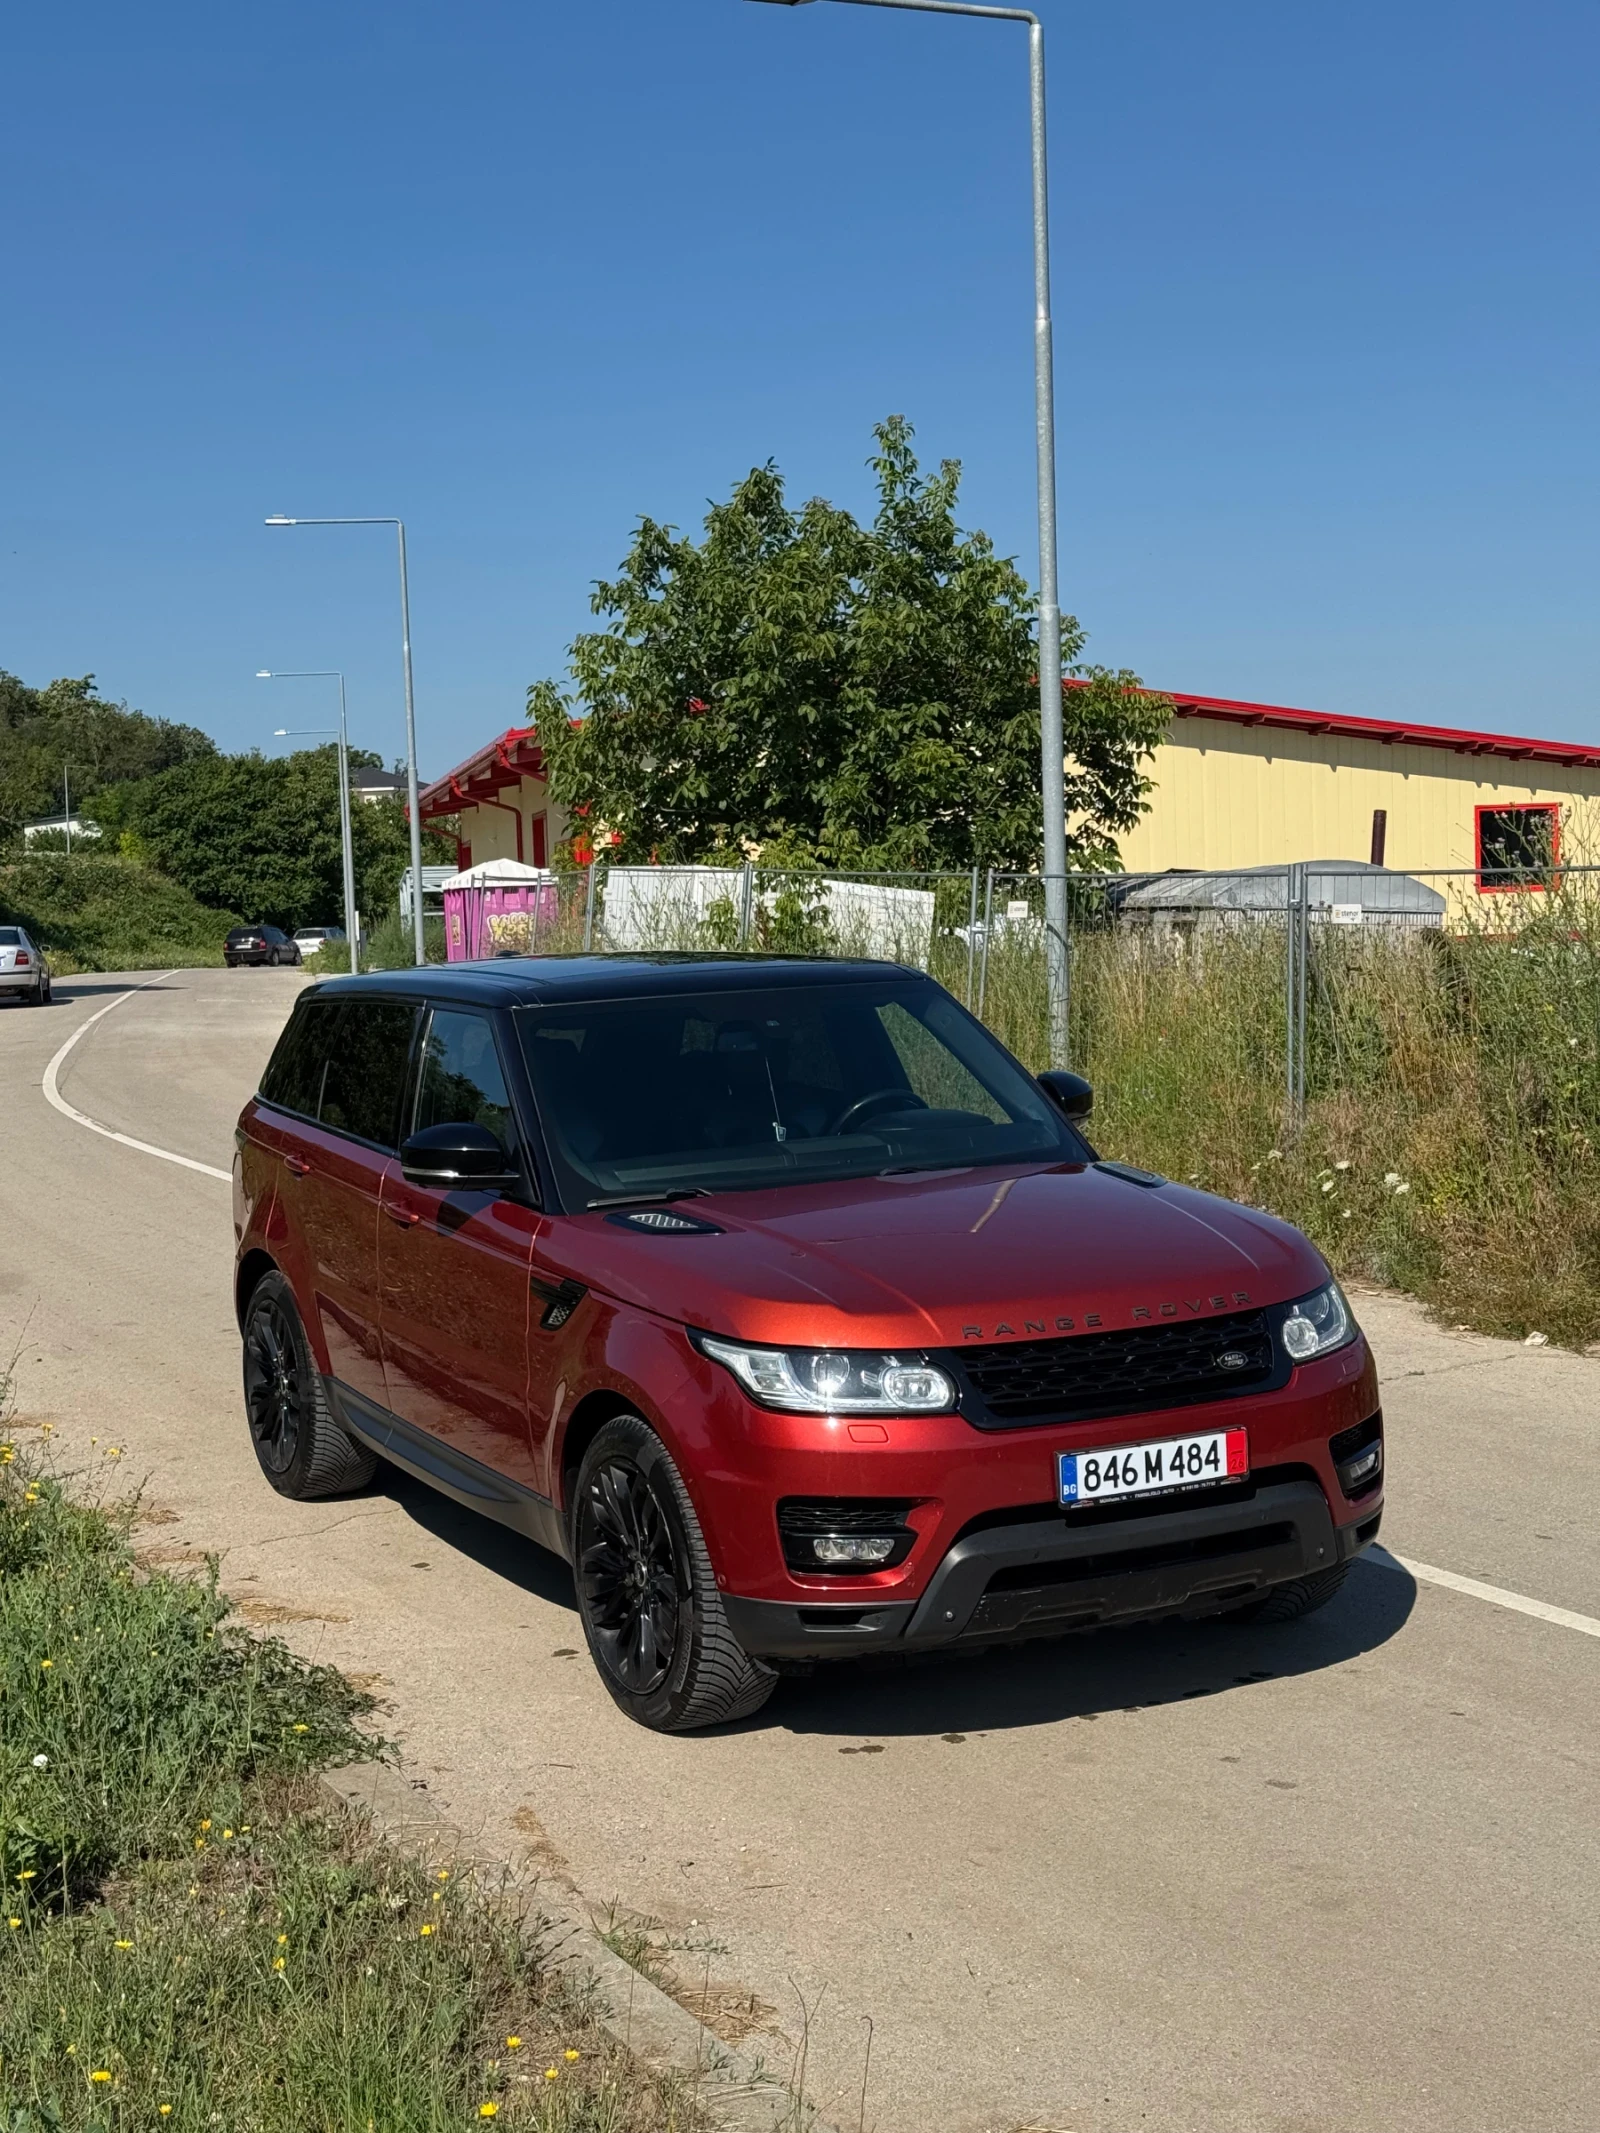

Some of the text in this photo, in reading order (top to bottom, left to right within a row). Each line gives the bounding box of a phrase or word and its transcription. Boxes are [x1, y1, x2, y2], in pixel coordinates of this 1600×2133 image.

[962, 1291, 1253, 1339] RANGE ROVER
[1083, 1439, 1220, 1492] 846 M 484
[1229, 1457, 1245, 1470] 26
[1063, 1483, 1077, 1496] BG
